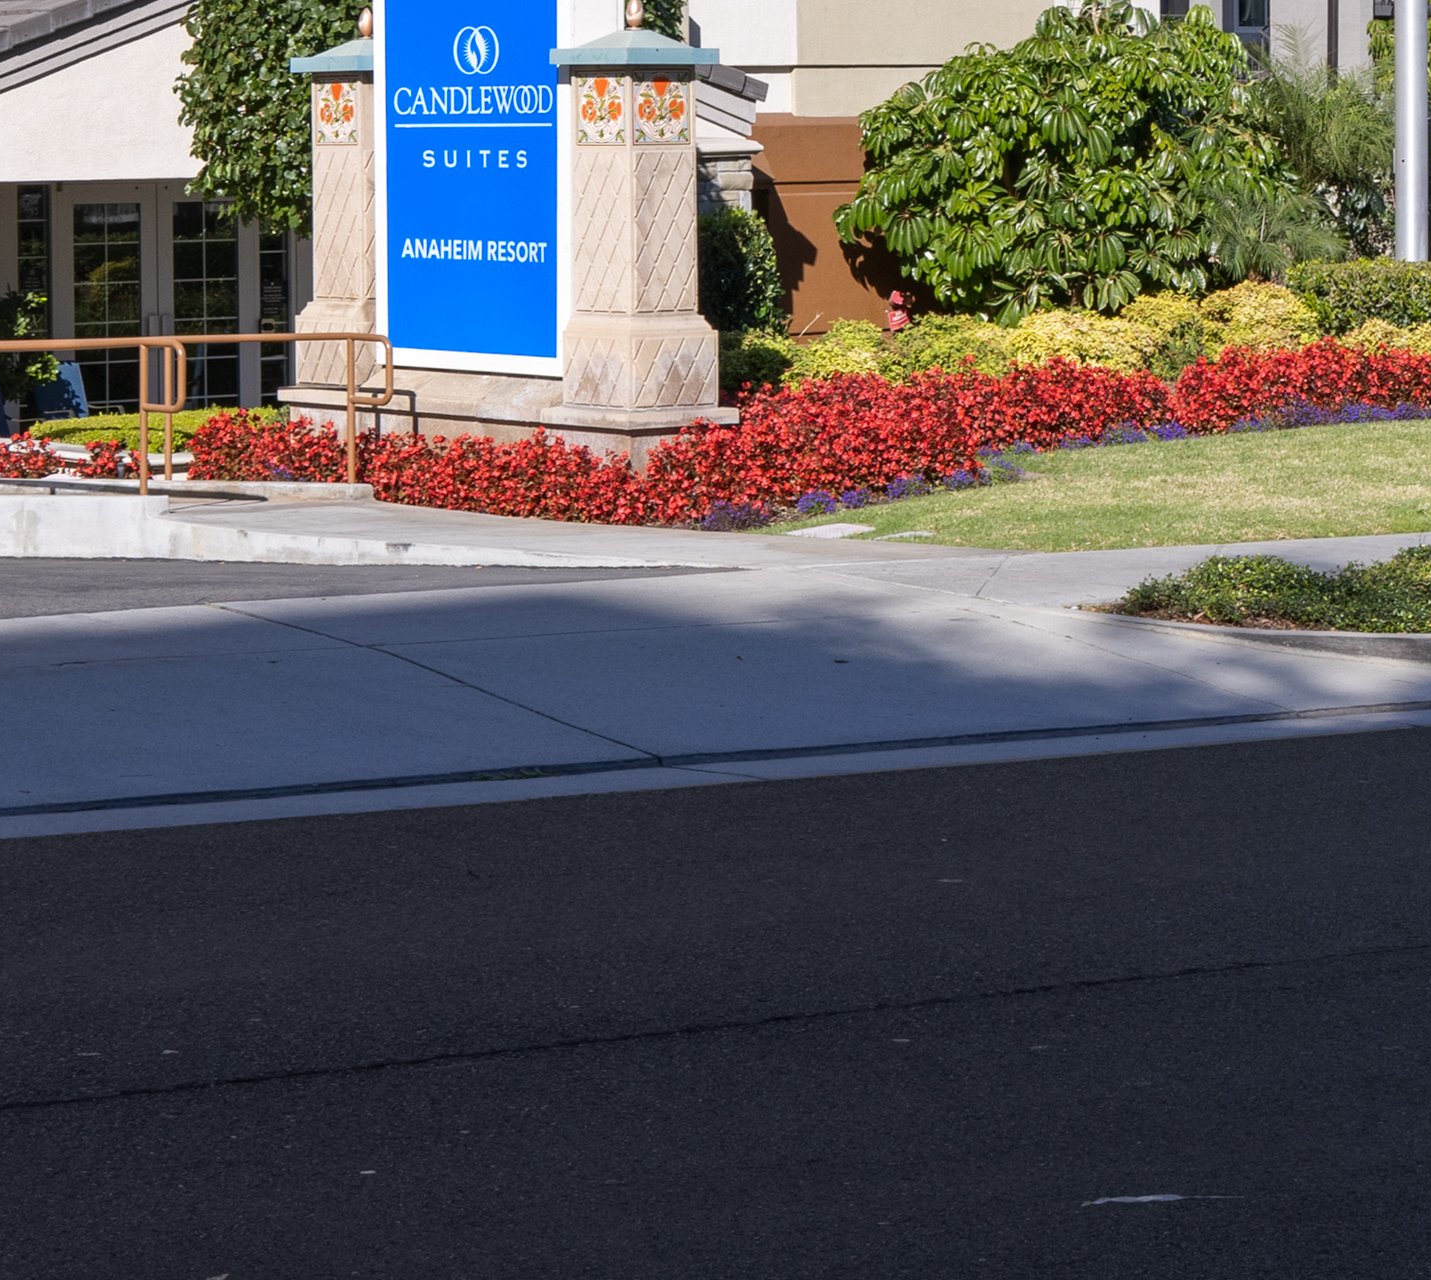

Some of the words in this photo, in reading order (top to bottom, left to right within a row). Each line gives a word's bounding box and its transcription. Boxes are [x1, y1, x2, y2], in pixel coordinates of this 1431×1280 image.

[393, 84, 554, 116] CANDLEWOOD
[422, 149, 528, 168] SUITES
[401, 238, 483, 260] ANAHEIM
[487, 240, 548, 263] RESORT
